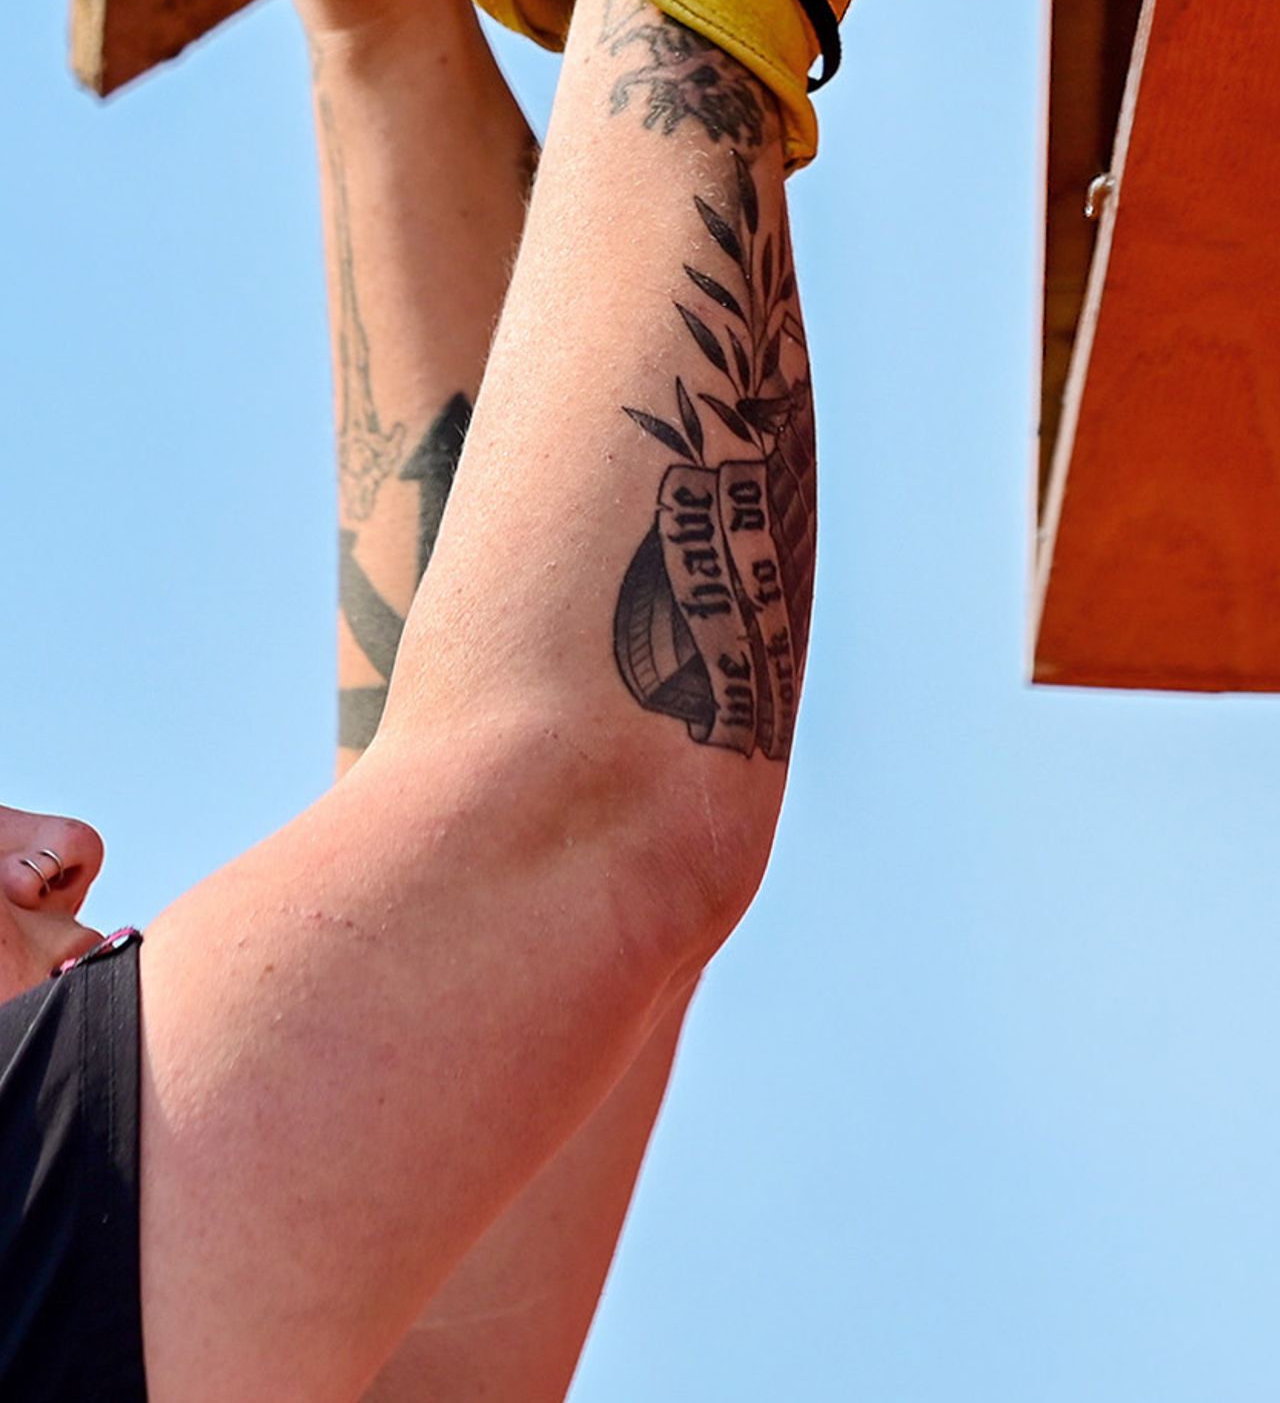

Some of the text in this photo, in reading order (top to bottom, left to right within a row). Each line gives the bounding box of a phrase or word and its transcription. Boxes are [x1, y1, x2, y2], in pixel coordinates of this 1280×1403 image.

[726, 479, 766, 532] do
[668, 485, 732, 619] have
[751, 559, 782, 609] to
